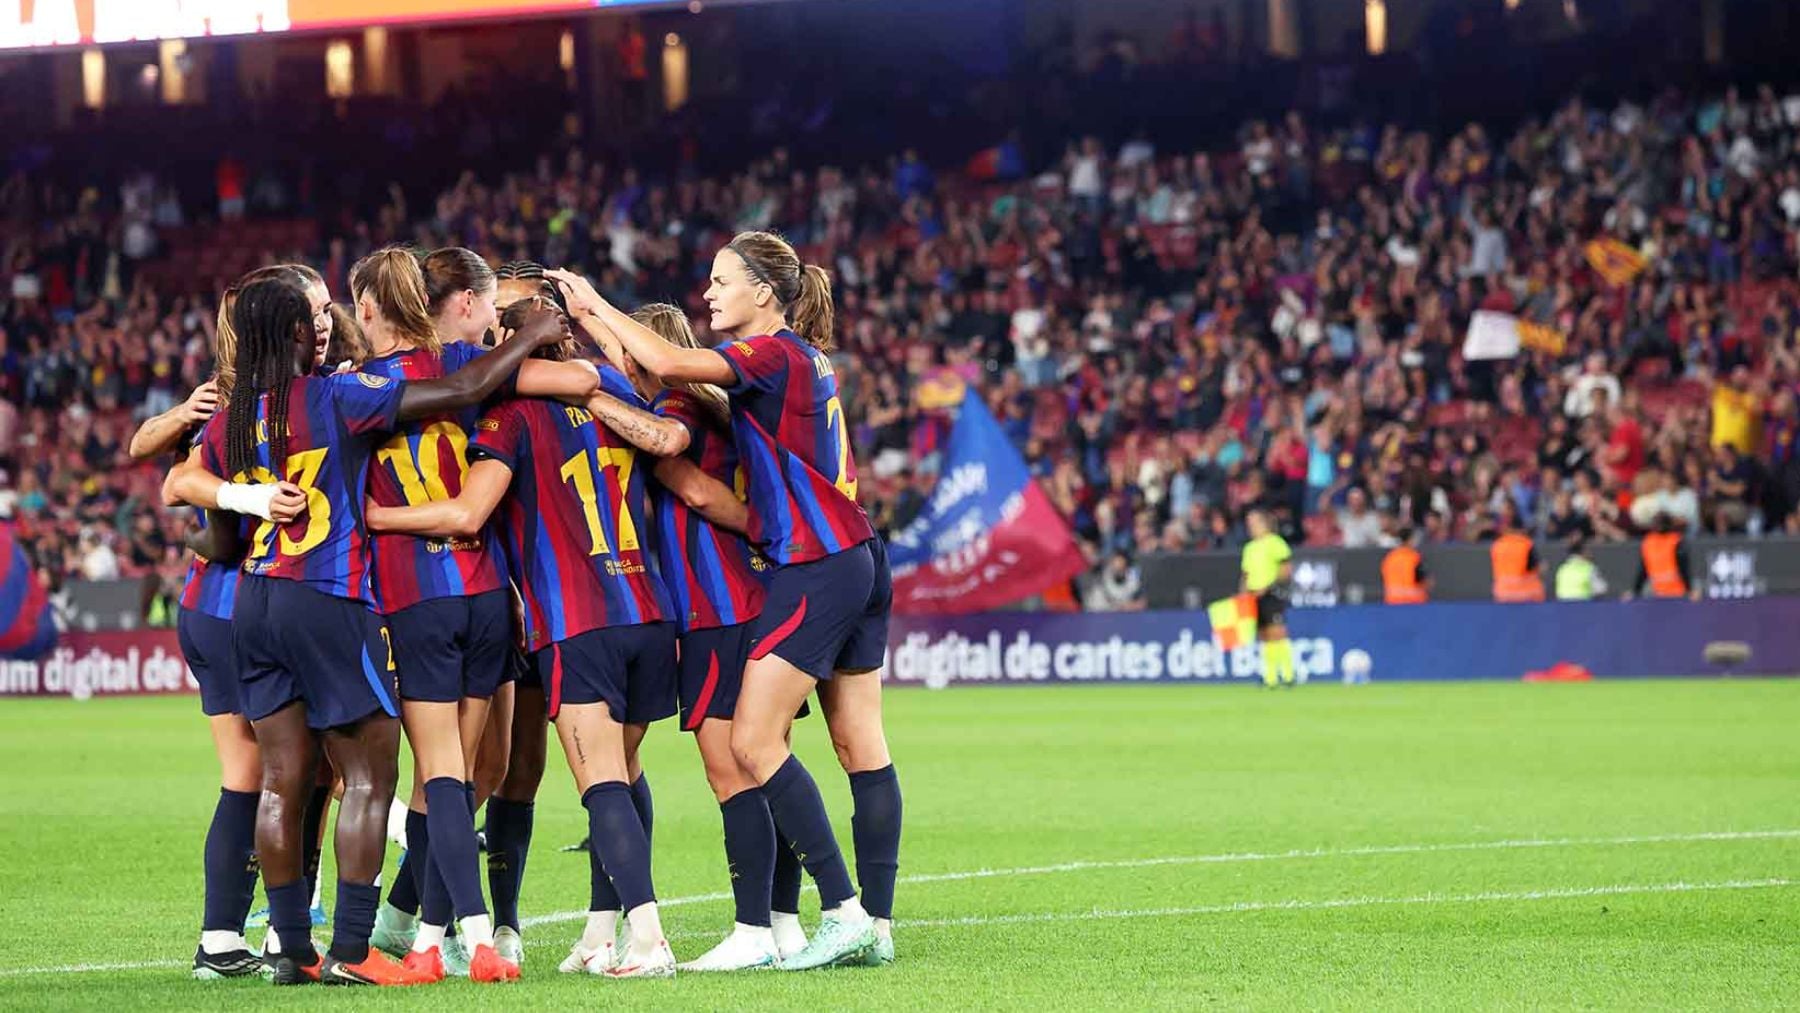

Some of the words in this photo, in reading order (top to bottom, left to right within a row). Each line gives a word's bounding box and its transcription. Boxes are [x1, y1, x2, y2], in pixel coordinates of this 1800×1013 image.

[377, 421, 468, 507] 10
[560, 446, 640, 556] 17
[44, 646, 139, 700] digital
[142, 646, 183, 690] de
[380, 627, 395, 671] 2
[894, 630, 1001, 689] digital
[1004, 630, 1050, 680] de
[1054, 635, 1163, 680] cartes
[1231, 638, 1334, 684] Bça
